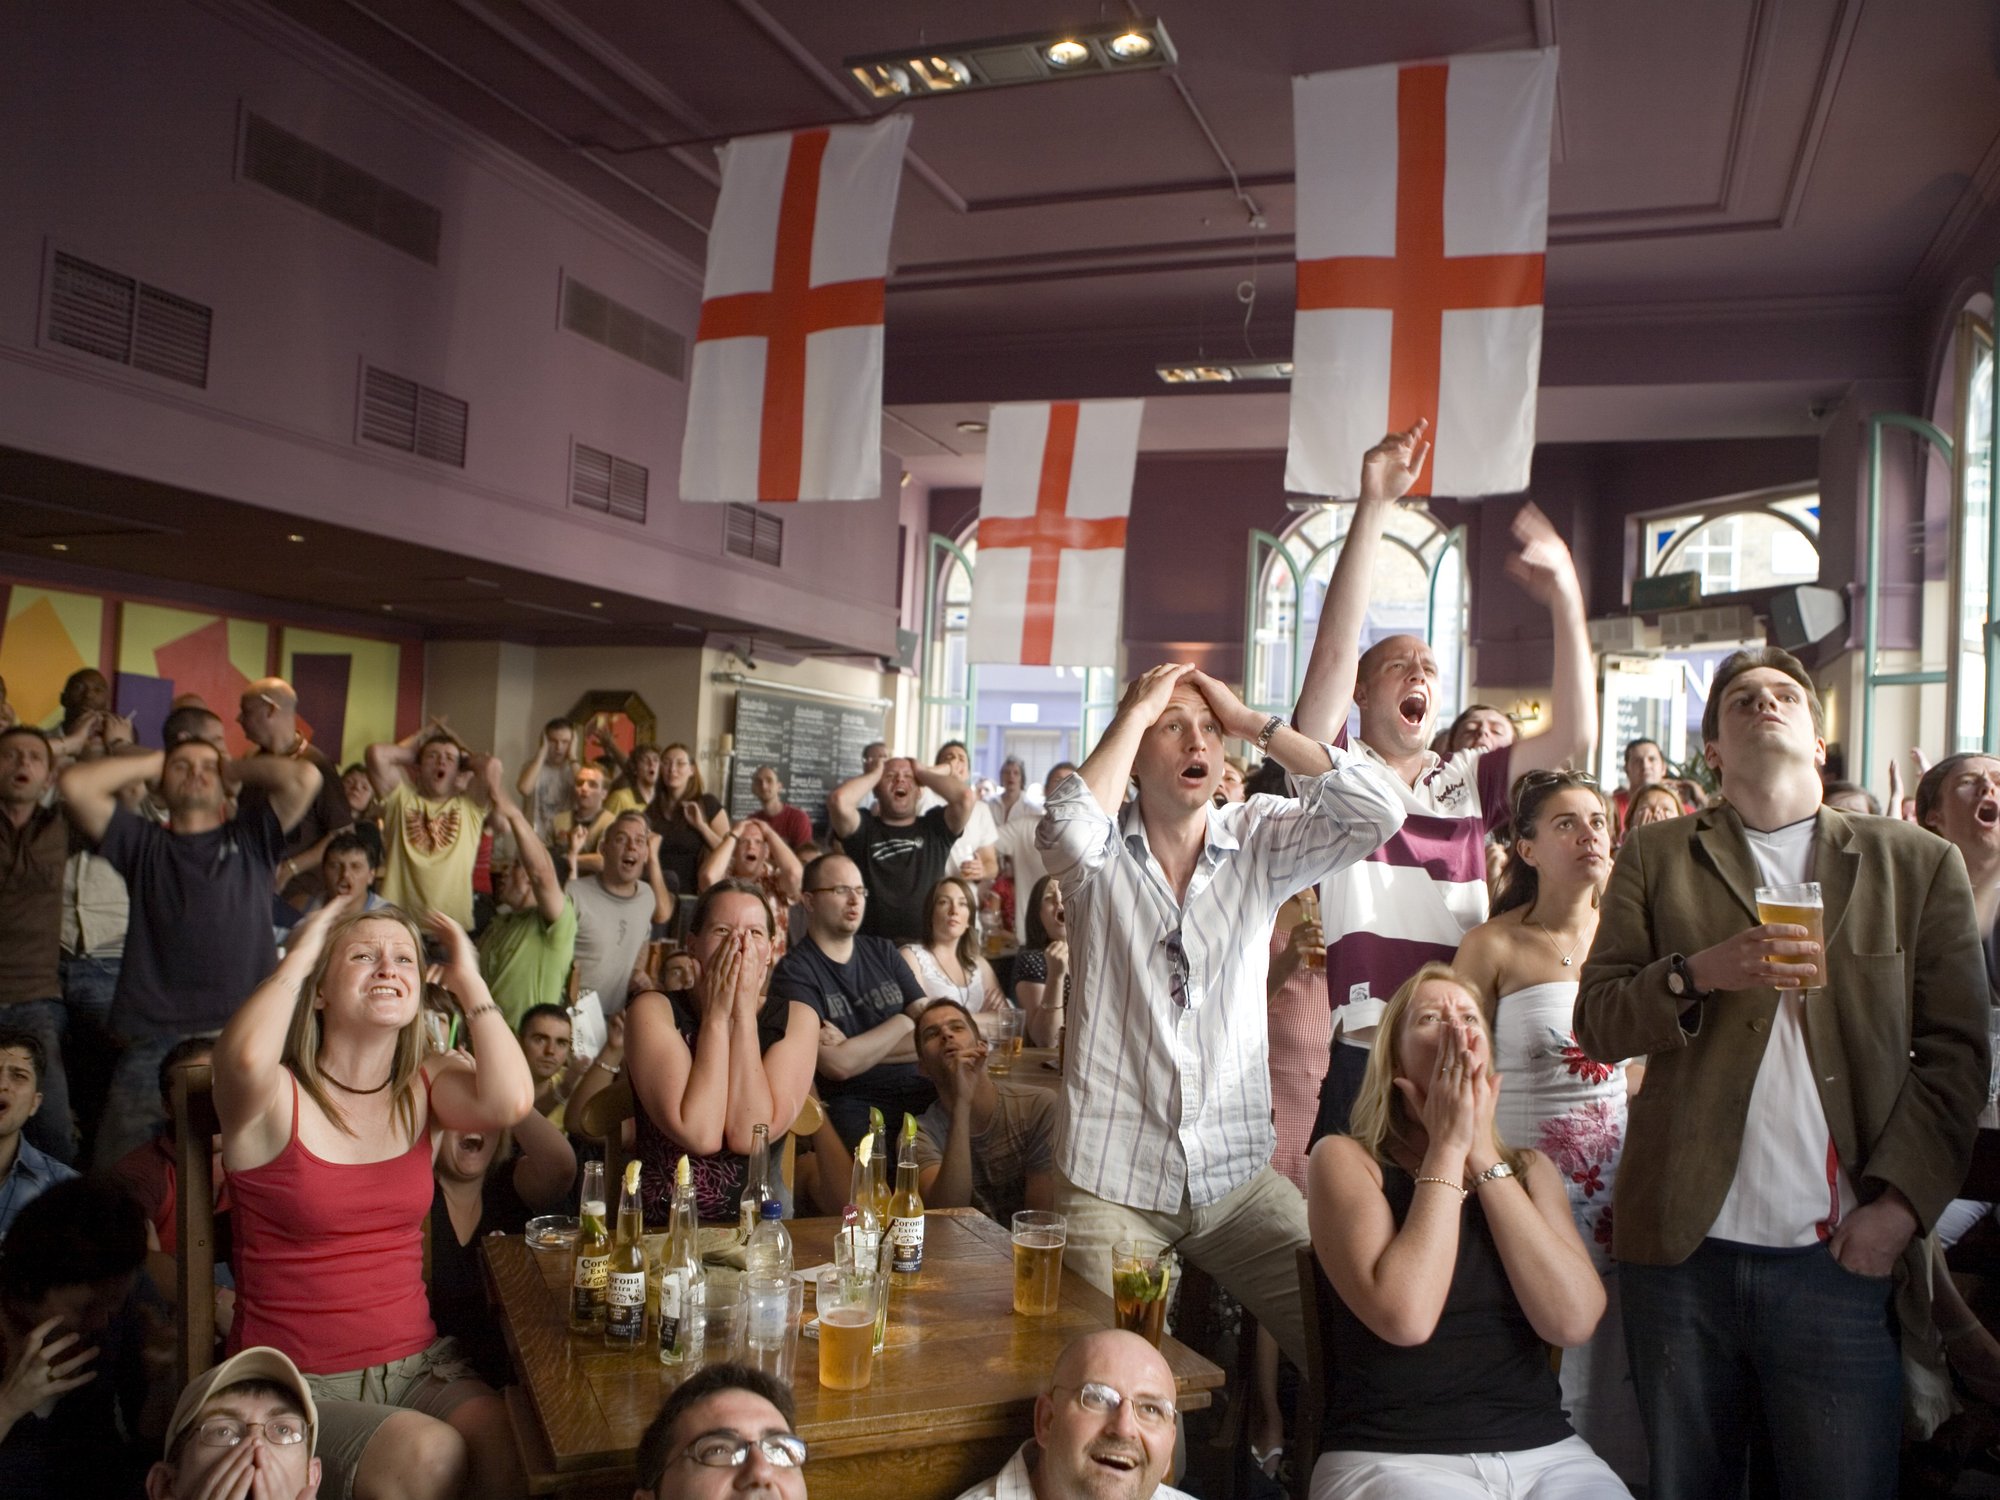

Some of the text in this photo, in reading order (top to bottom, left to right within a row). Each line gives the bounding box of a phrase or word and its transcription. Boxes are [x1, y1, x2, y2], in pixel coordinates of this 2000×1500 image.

[893, 1218, 923, 1227] Corona
[581, 1258, 608, 1269] Coro
[608, 1276, 640, 1285] orona
